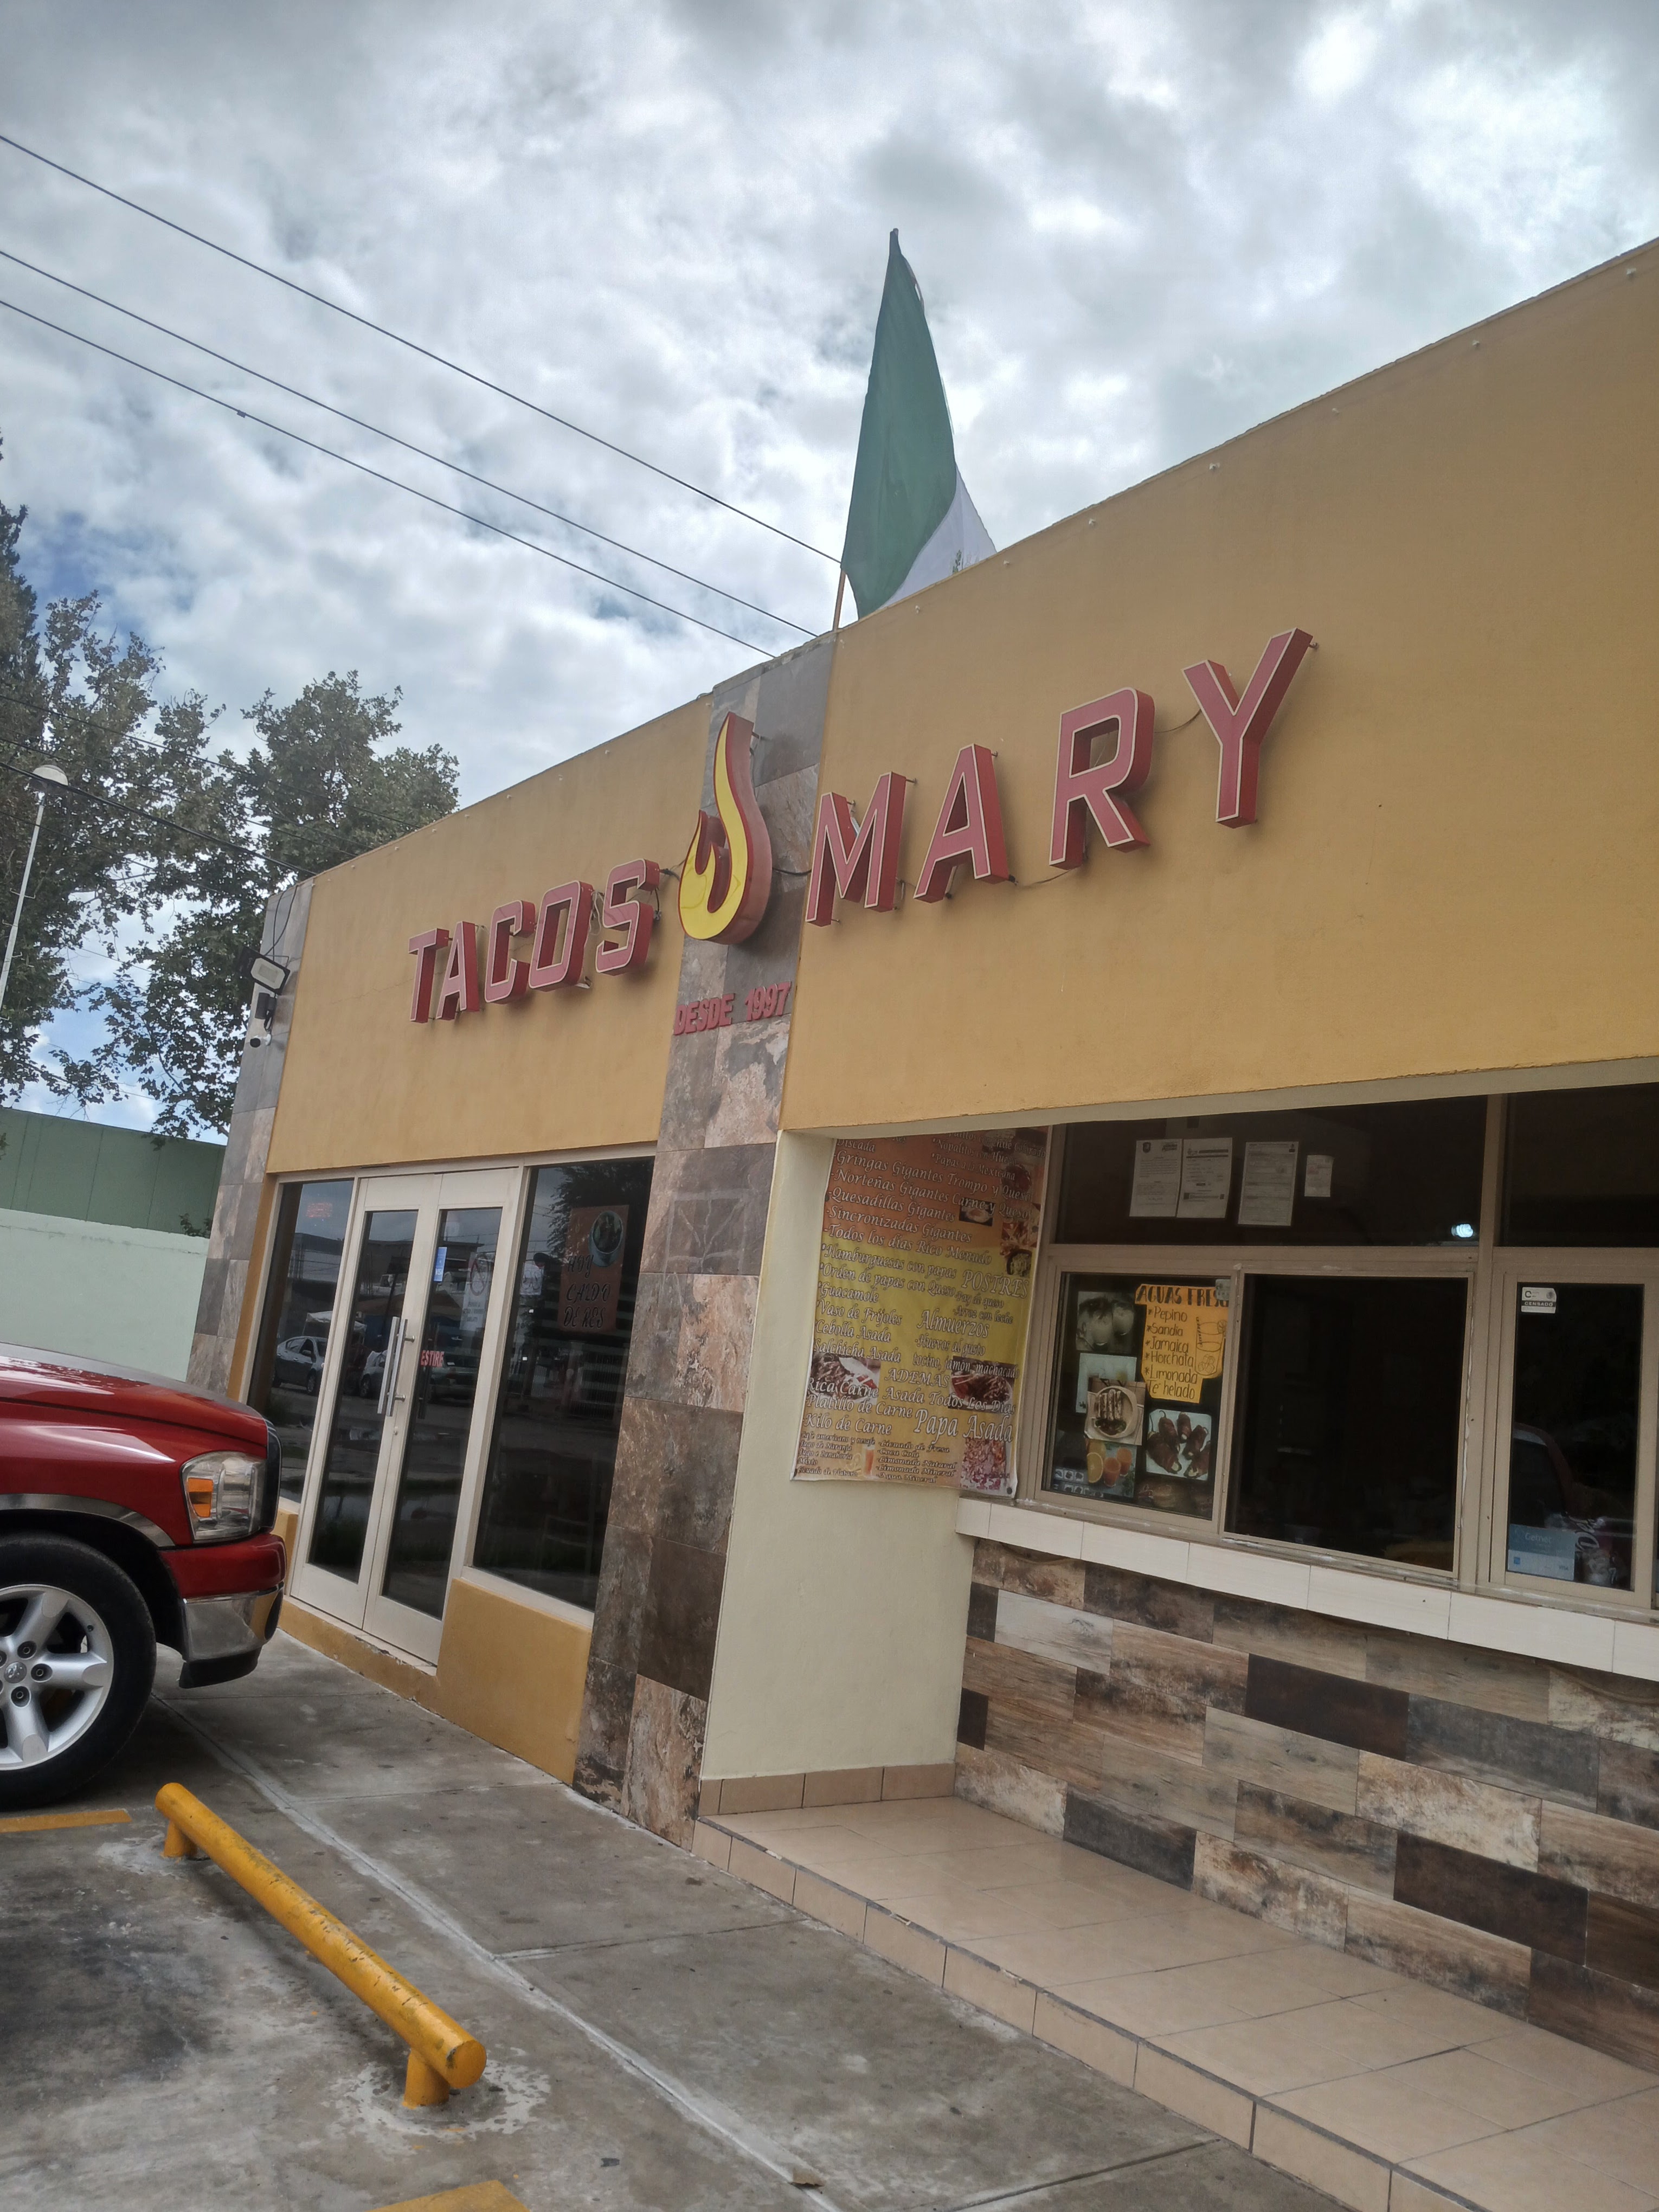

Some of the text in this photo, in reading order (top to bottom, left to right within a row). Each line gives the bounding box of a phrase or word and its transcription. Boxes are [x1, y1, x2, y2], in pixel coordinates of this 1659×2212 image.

[408, 627, 1314, 1024] TACOS MARY
[673, 981, 792, 1036] DESDE 1997
[837, 1139, 875, 1152] Discada
[935, 1154, 959, 1168] Papas
[968, 1161, 975, 1171] la
[978, 1165, 1015, 1181] Mexicana
[893, 1161, 943, 1183] Gigantes
[948, 1173, 987, 1194] Trompo
[992, 1186, 999, 1198] y
[1002, 1186, 1031, 1201] Queso
[900, 1181, 949, 1202] Gigantes
[953, 1193, 986, 1209] Carne
[989, 1202, 996, 1215] y
[999, 1203, 1029, 1219] Queso
[908, 1201, 955, 1222] Gigantes
[923, 1223, 972, 1243] Gigantes
[868, 1230, 885, 1245] los
[916, 1240, 942, 1256] Rico
[946, 1246, 992, 1265] Menudo
[907, 1261, 925, 1273] con
[924, 1264, 957, 1280] papas
[858, 1268, 871, 1283] de
[871, 1275, 905, 1290] papas
[907, 1280, 925, 1291] con
[928, 1280, 955, 1296] Queso
[962, 1270, 1029, 1298] POSTRES
[566, 1283, 611, 1303] CALDO
[1136, 1285, 1182, 1304] AGUAS
[982, 1297, 1005, 1310] queso
[564, 1306, 606, 1328] DE RES
[847, 1303, 859, 1319] de
[861, 1307, 902, 1327] Frijoles
[917, 1308, 989, 1338] Almuerzos
[979, 1311, 992, 1321] con
[994, 1310, 1013, 1323] leche
[857, 1326, 891, 1342] Asada
[867, 1346, 901, 1363] Asada
[952, 1338, 963, 1353] al
[962, 1343, 986, 1358] gusto
[420, 1350, 445, 1367] ESTIRE
[976, 1362, 1020, 1379] machacado
[840, 1381, 879, 1397] Carne
[883, 1387, 924, 1403] Asada
[930, 1392, 964, 1408] Todos
[967, 1397, 988, 1411] Los
[1163, 1381, 1195, 1399] helado
[857, 1399, 873, 1414] de
[876, 1402, 912, 1418] Carne
[835, 1416, 851, 1431] de
[855, 1418, 892, 1435] Carne
[914, 1409, 1013, 1444] Papa Asada
[820, 1451, 852, 1460] Zanahoria
[825, 1443, 852, 1452] Naranja
[921, 1468, 956, 1477] Mineral
[922, 1460, 957, 1469] Natural
